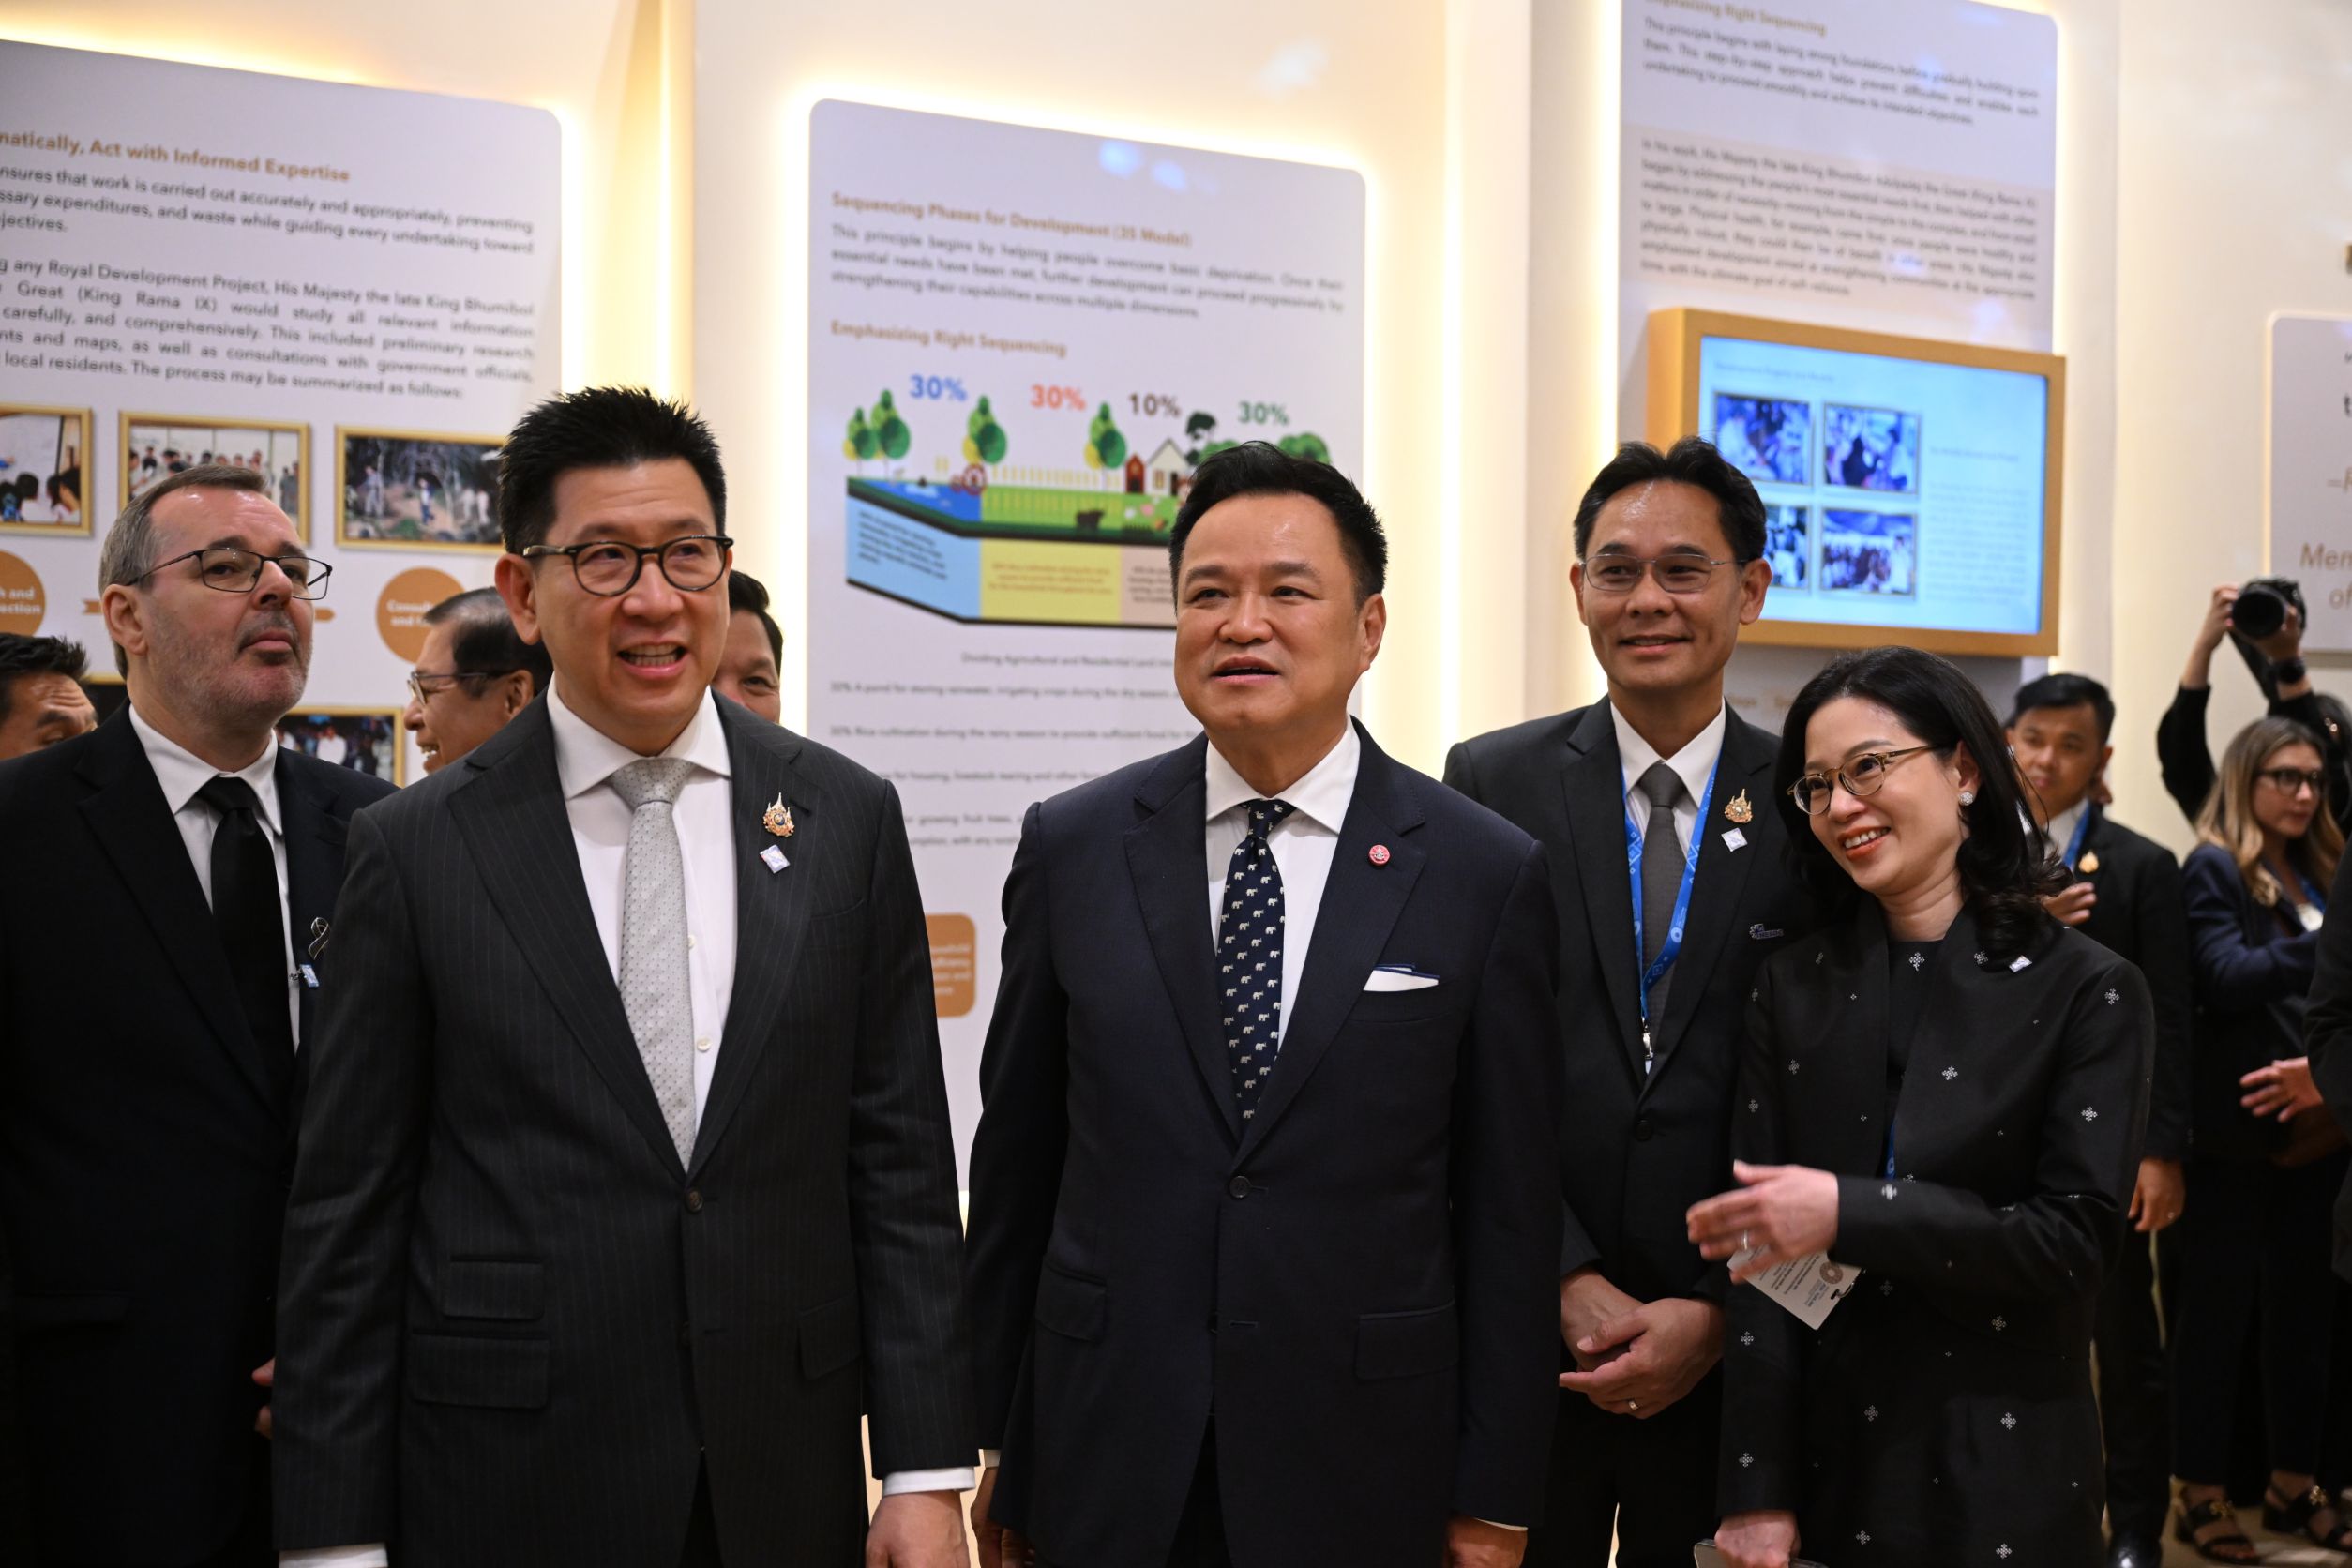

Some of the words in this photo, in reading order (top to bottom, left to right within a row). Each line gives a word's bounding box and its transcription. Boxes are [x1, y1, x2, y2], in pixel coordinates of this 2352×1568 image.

[90, 140, 120, 156] Act
[127, 146, 168, 160] with
[173, 148, 260, 172] Informed
[264, 158, 349, 181] Expertise
[56, 170, 86, 186] that
[92, 176, 129, 189] work
[135, 179, 146, 193] is
[151, 183, 206, 199] carried
[210, 188, 235, 202] out
[239, 191, 315, 212] accurately
[320, 200, 348, 213] and
[158, 206, 188, 219] and
[191, 211, 235, 224] waste
[241, 214, 280, 229] while
[285, 219, 344, 239] guiding
[347, 226, 387, 242] every
[13, 260, 42, 277] any
[48, 259, 92, 279] Royal
[98, 264, 207, 287] Development
[274, 281, 298, 295] His
[302, 282, 360, 303] Majesty
[366, 290, 389, 304] the
[17, 280, 63, 298] Great
[77, 286, 121, 308] (King
[135, 291, 180, 309] Rama
[194, 296, 218, 312] IX)
[231, 303, 279, 317] would
[293, 308, 333, 324] study
[347, 310, 365, 324] all
[4, 350, 43, 368] local
[133, 359, 159, 376] The
[165, 366, 225, 381] process
[230, 370, 263, 386] may
[266, 371, 287, 385] be
[291, 375, 384, 393] summarized
[910, 373, 967, 401] 30%
[1030, 384, 1087, 411] 30%
[1129, 392, 1182, 418] 10%
[1238, 400, 1290, 426] 30%
[8, 585, 34, 600] and
